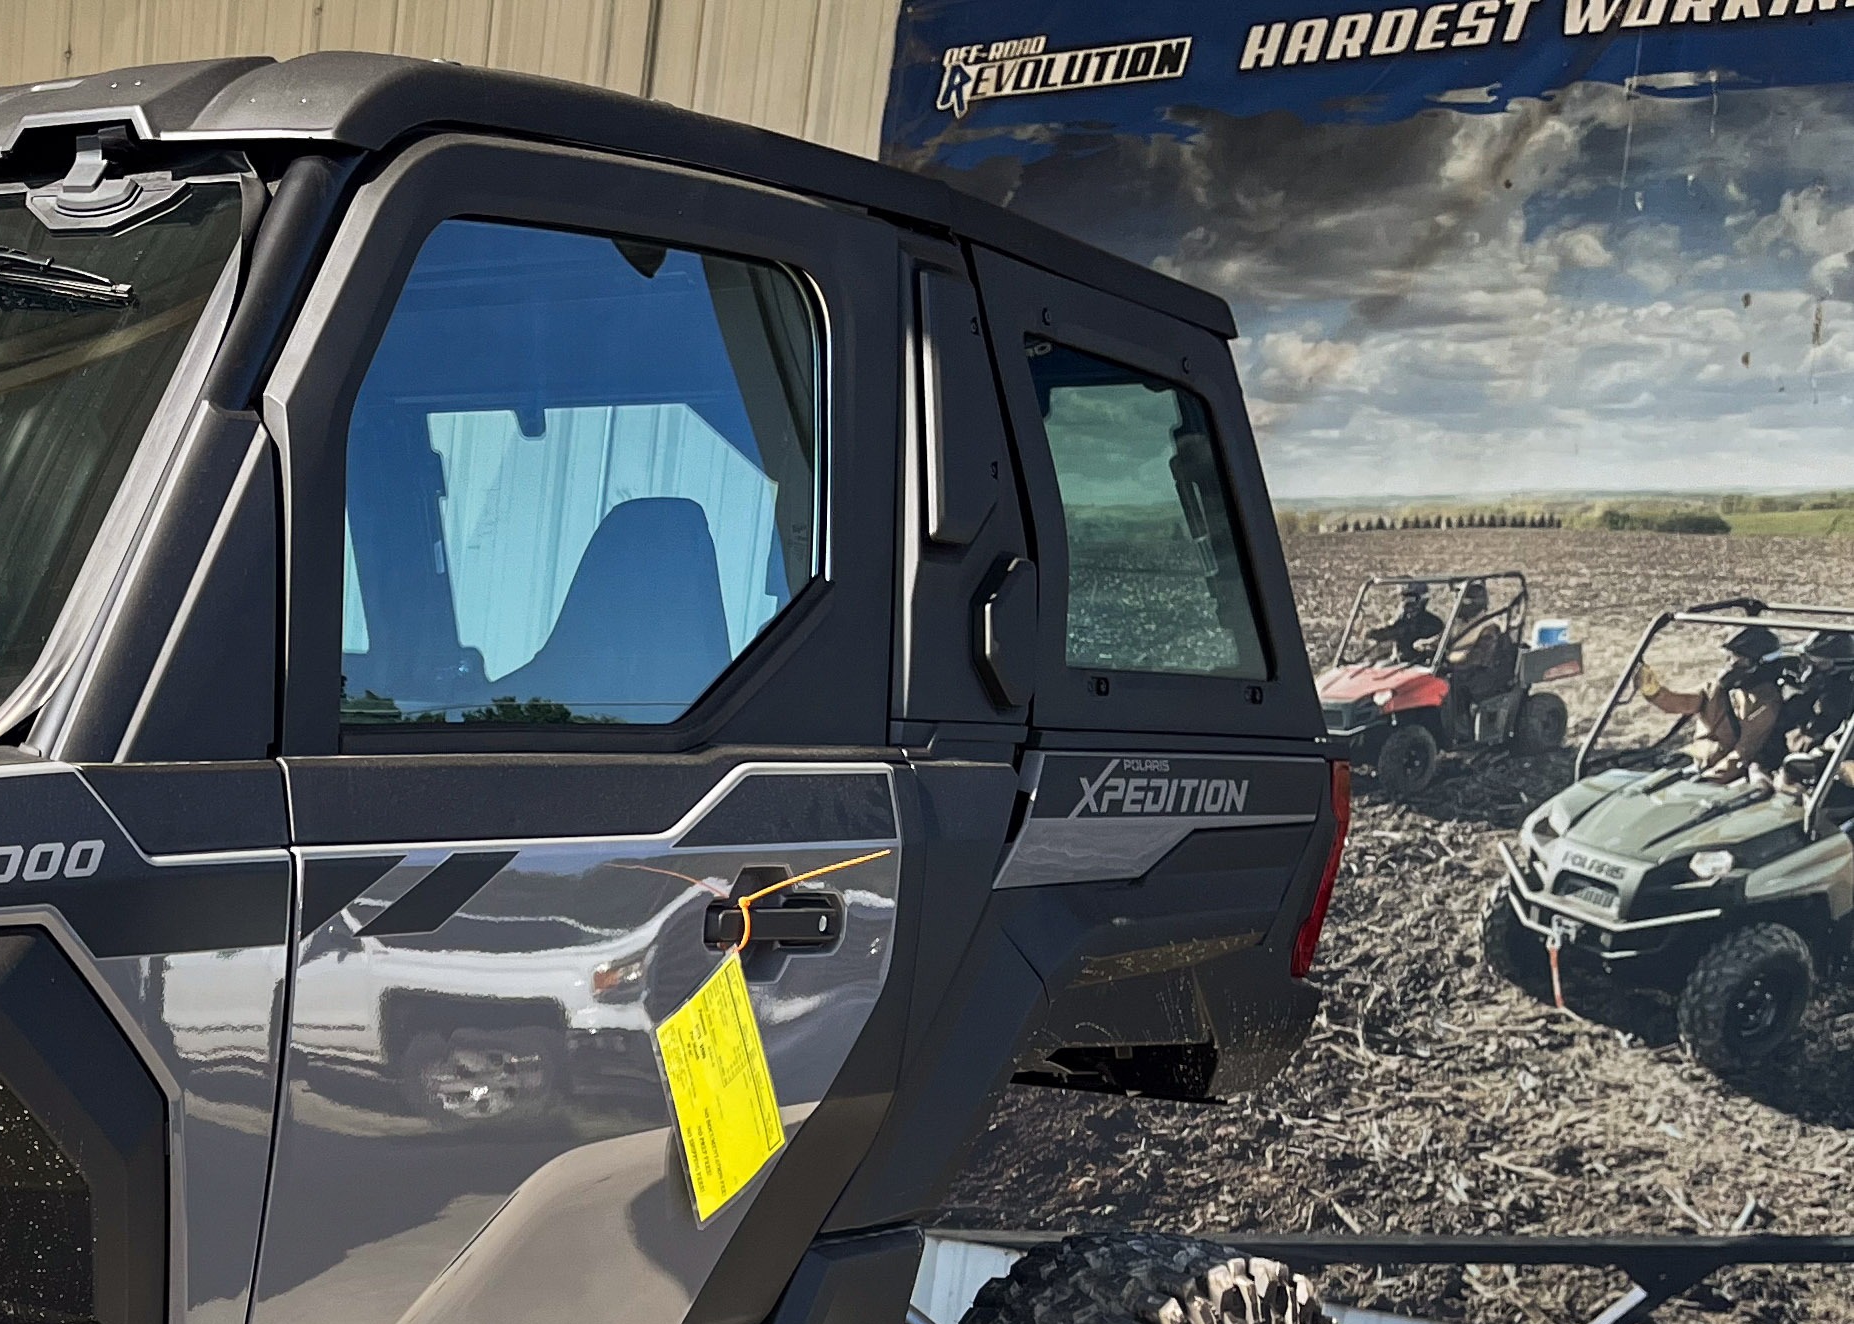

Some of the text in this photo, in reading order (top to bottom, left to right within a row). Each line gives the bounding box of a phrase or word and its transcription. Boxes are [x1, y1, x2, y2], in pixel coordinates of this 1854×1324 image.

[943, 35, 1047, 66] OFF-ROAD
[1239, 0, 1540, 71] HARDEST
[936, 37, 1192, 119] REVOLUTION
[1067, 758, 1250, 820] XPEDITION
[1123, 759, 1171, 772] POLARIS
